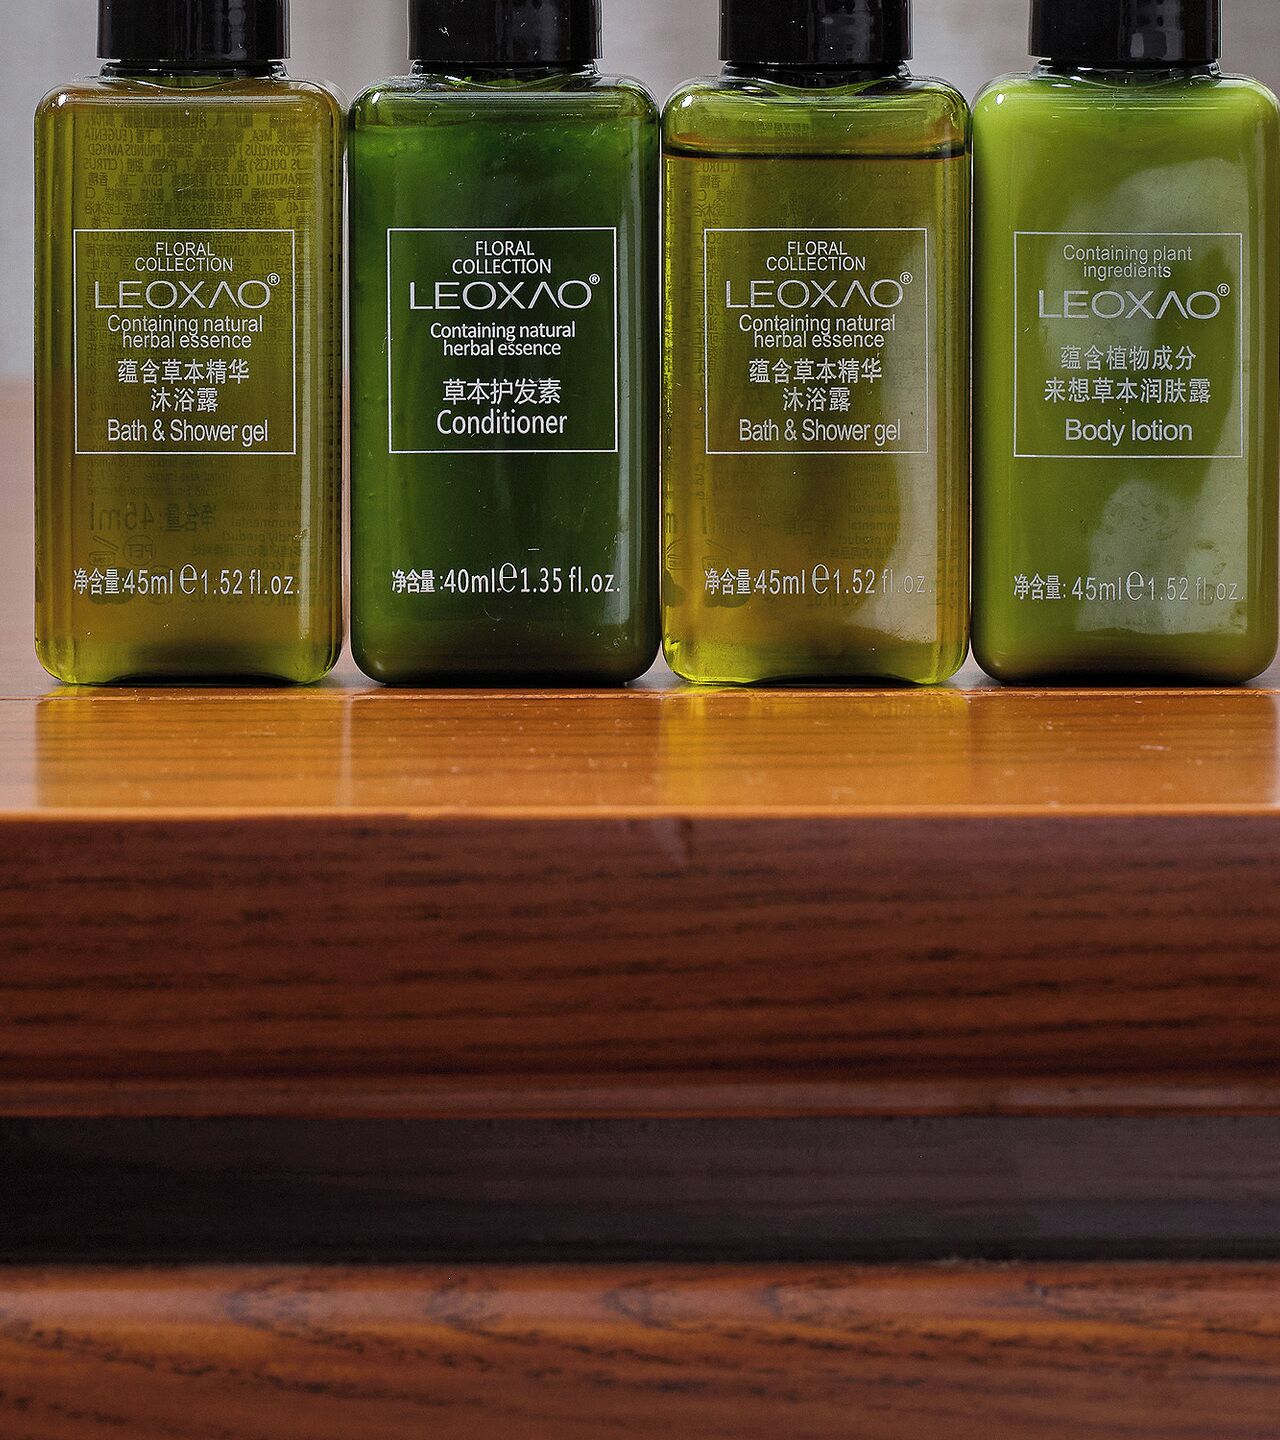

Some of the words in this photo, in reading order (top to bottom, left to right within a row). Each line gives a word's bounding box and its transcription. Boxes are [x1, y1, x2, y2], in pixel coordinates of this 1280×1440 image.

[155, 242, 215, 257] FLORAL
[475, 241, 534, 256] FLORAL
[788, 241, 847, 256] FLORAL
[1063, 244, 1147, 264] Containing
[1153, 246, 1192, 263] plant
[134, 257, 233, 271] COLLECTION
[452, 259, 551, 274] COLLECTION
[766, 256, 865, 271] COLLECTION
[1083, 263, 1171, 281] ingredients
[108, 315, 198, 335] Containing
[204, 315, 263, 332] natural
[430, 322, 515, 341] Containing
[520, 321, 575, 338] natural
[739, 314, 830, 334] Containing
[835, 314, 895, 332] natural
[123, 331, 175, 348] herbal
[179, 334, 251, 348] essence
[443, 340, 494, 356] herbal
[498, 342, 561, 355] essence
[754, 331, 807, 348] herbal
[812, 333, 884, 348] essence
[1061, 345, 1196, 371] 蕴含植物成分
[118, 359, 250, 384] 蕴含草本精华
[749, 358, 882, 384] 蕴含草本精华
[151, 388, 218, 412] 沐浴露
[443, 378, 561, 405] 草本护发素
[783, 387, 851, 412] 沐浴露
[1044, 377, 1211, 403] 来想草本润肤露
[436, 409, 567, 435] Conditioner
[108, 419, 147, 441] Bath
[152, 419, 166, 441] &
[170, 419, 238, 441] Shower
[242, 419, 268, 447] gel
[739, 419, 779, 441] Bath
[784, 419, 797, 441] &
[802, 419, 870, 441] Shower
[874, 419, 900, 446] gel
[1065, 419, 1125, 446] Body
[1132, 419, 1192, 441] lotion
